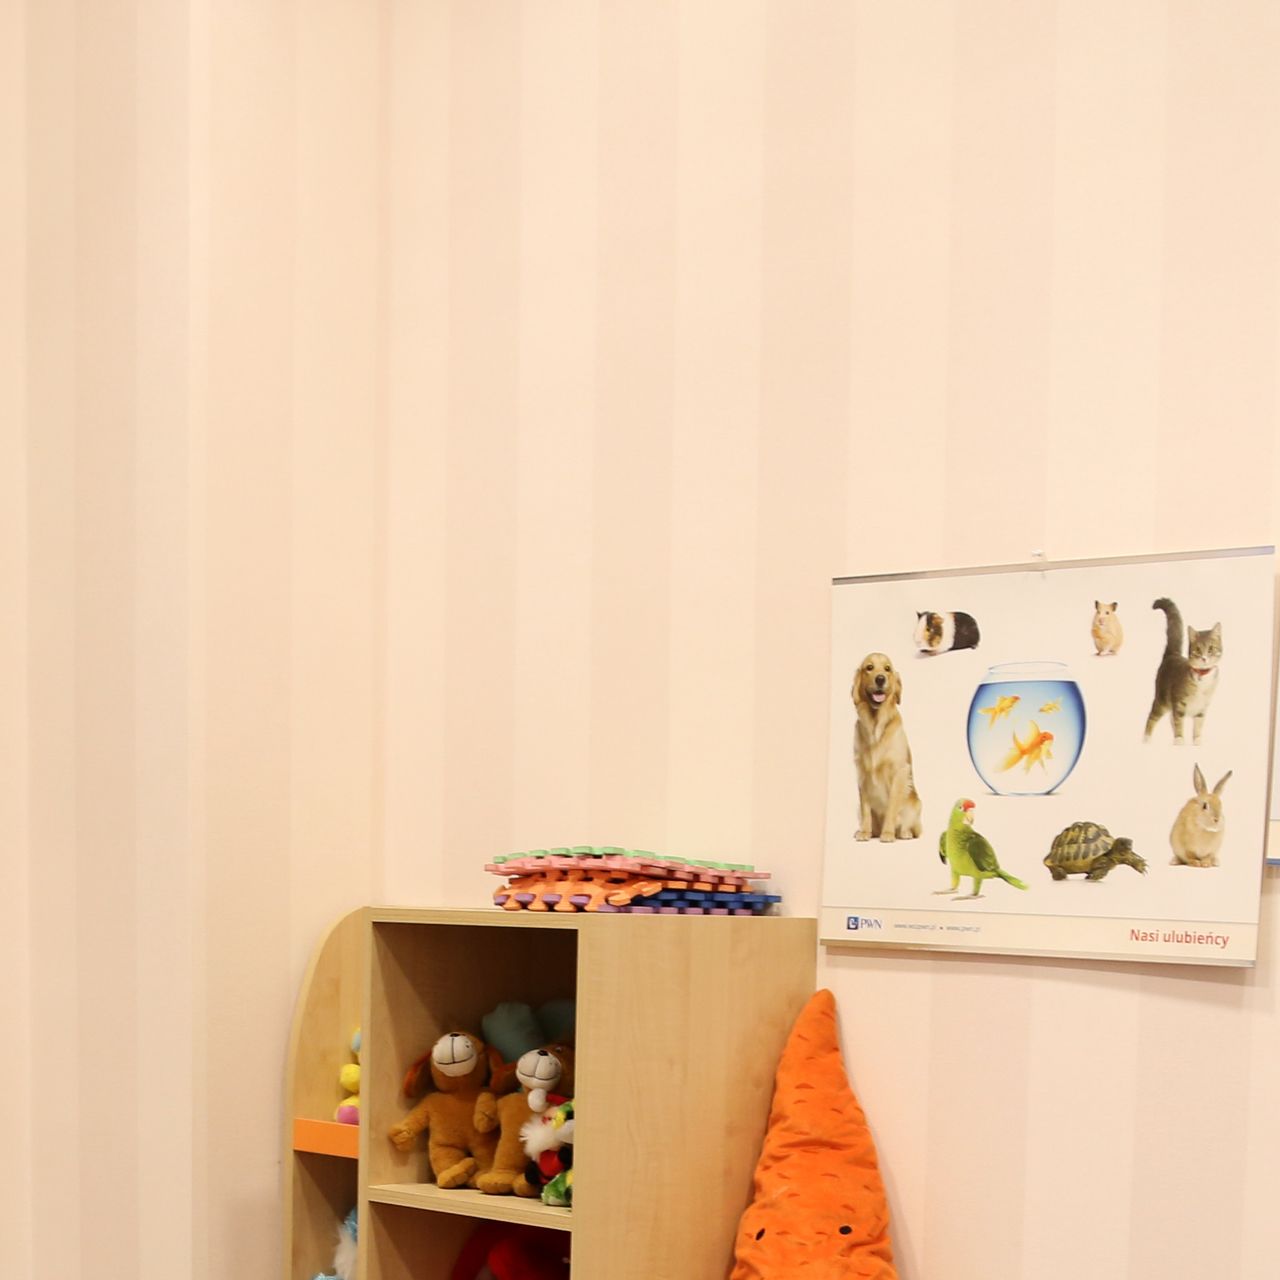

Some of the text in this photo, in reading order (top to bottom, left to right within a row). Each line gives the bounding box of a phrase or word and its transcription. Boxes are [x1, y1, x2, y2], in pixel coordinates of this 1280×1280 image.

[860, 918, 882, 929] PWN
[1130, 929, 1230, 949] Nasi ulubieńcy
